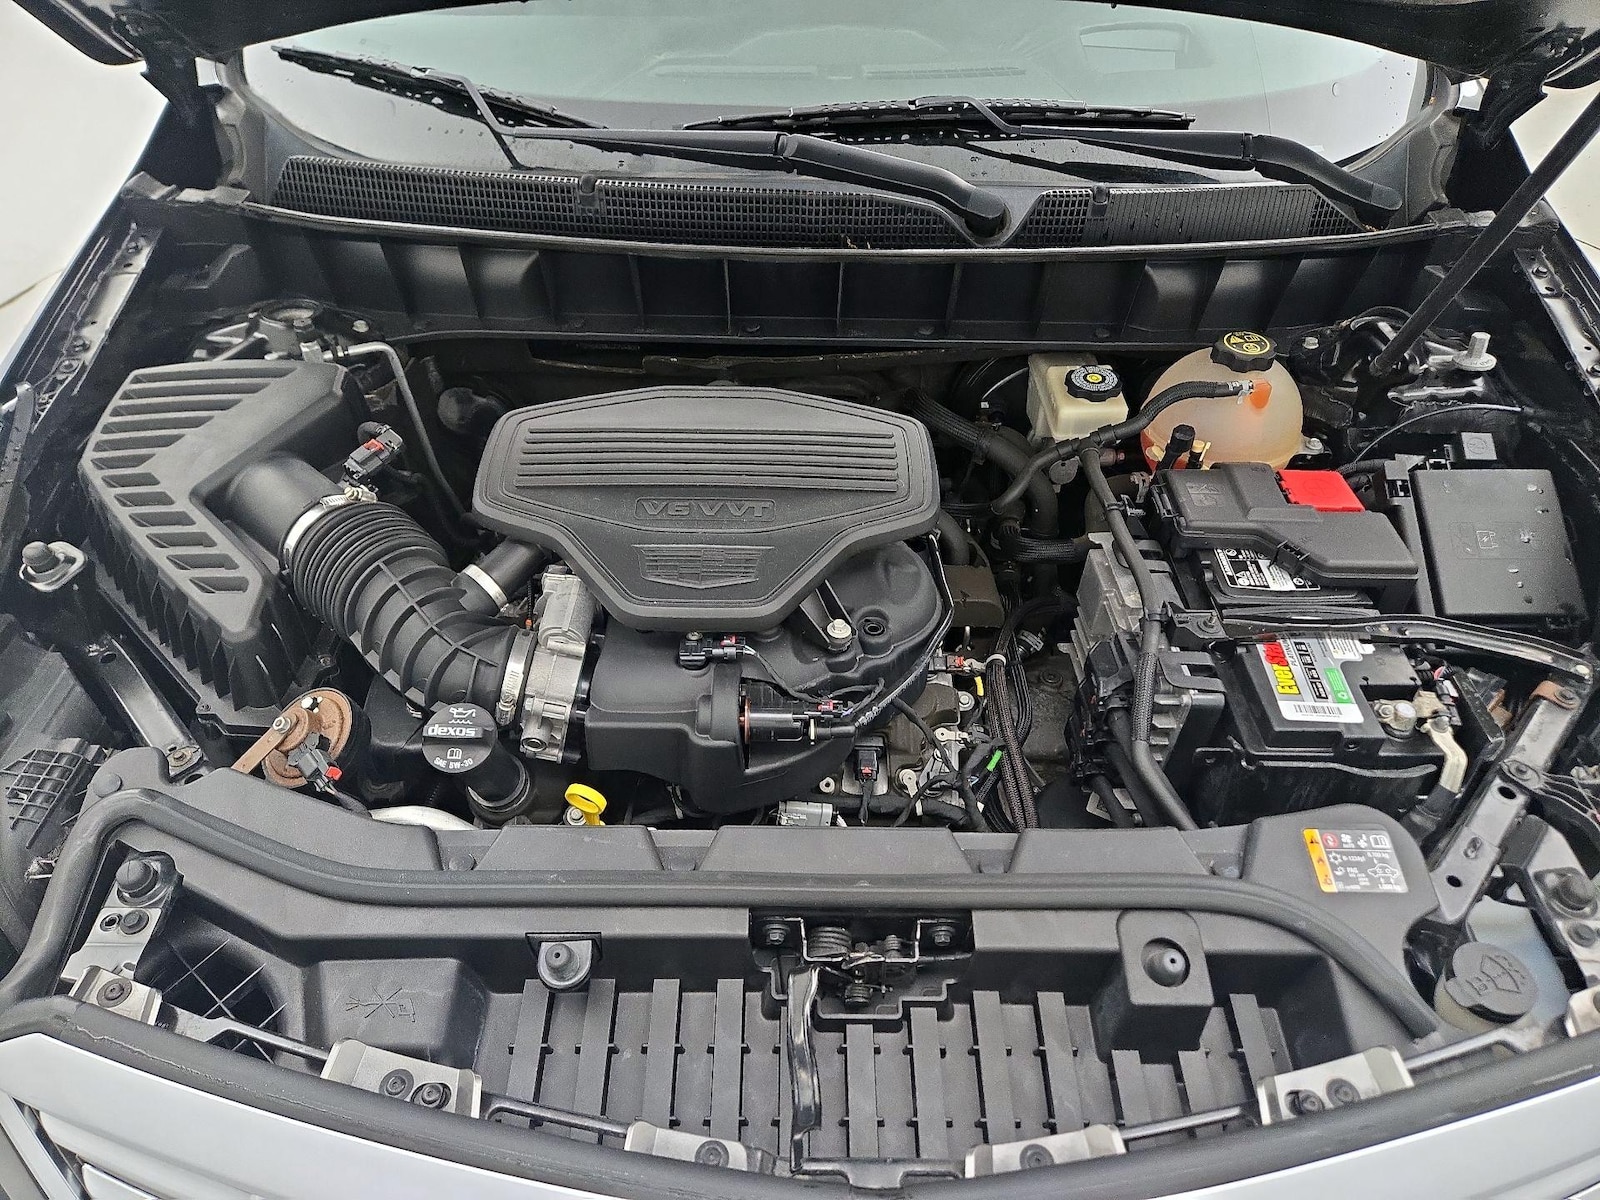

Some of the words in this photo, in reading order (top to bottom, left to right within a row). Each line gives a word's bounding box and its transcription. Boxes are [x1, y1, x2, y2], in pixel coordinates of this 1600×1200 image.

[642, 501, 690, 516] V6
[699, 502, 772, 517] VVT
[428, 724, 476, 737] dexos
[433, 757, 447, 768] SAE
[448, 758, 473, 769] 5W-30
